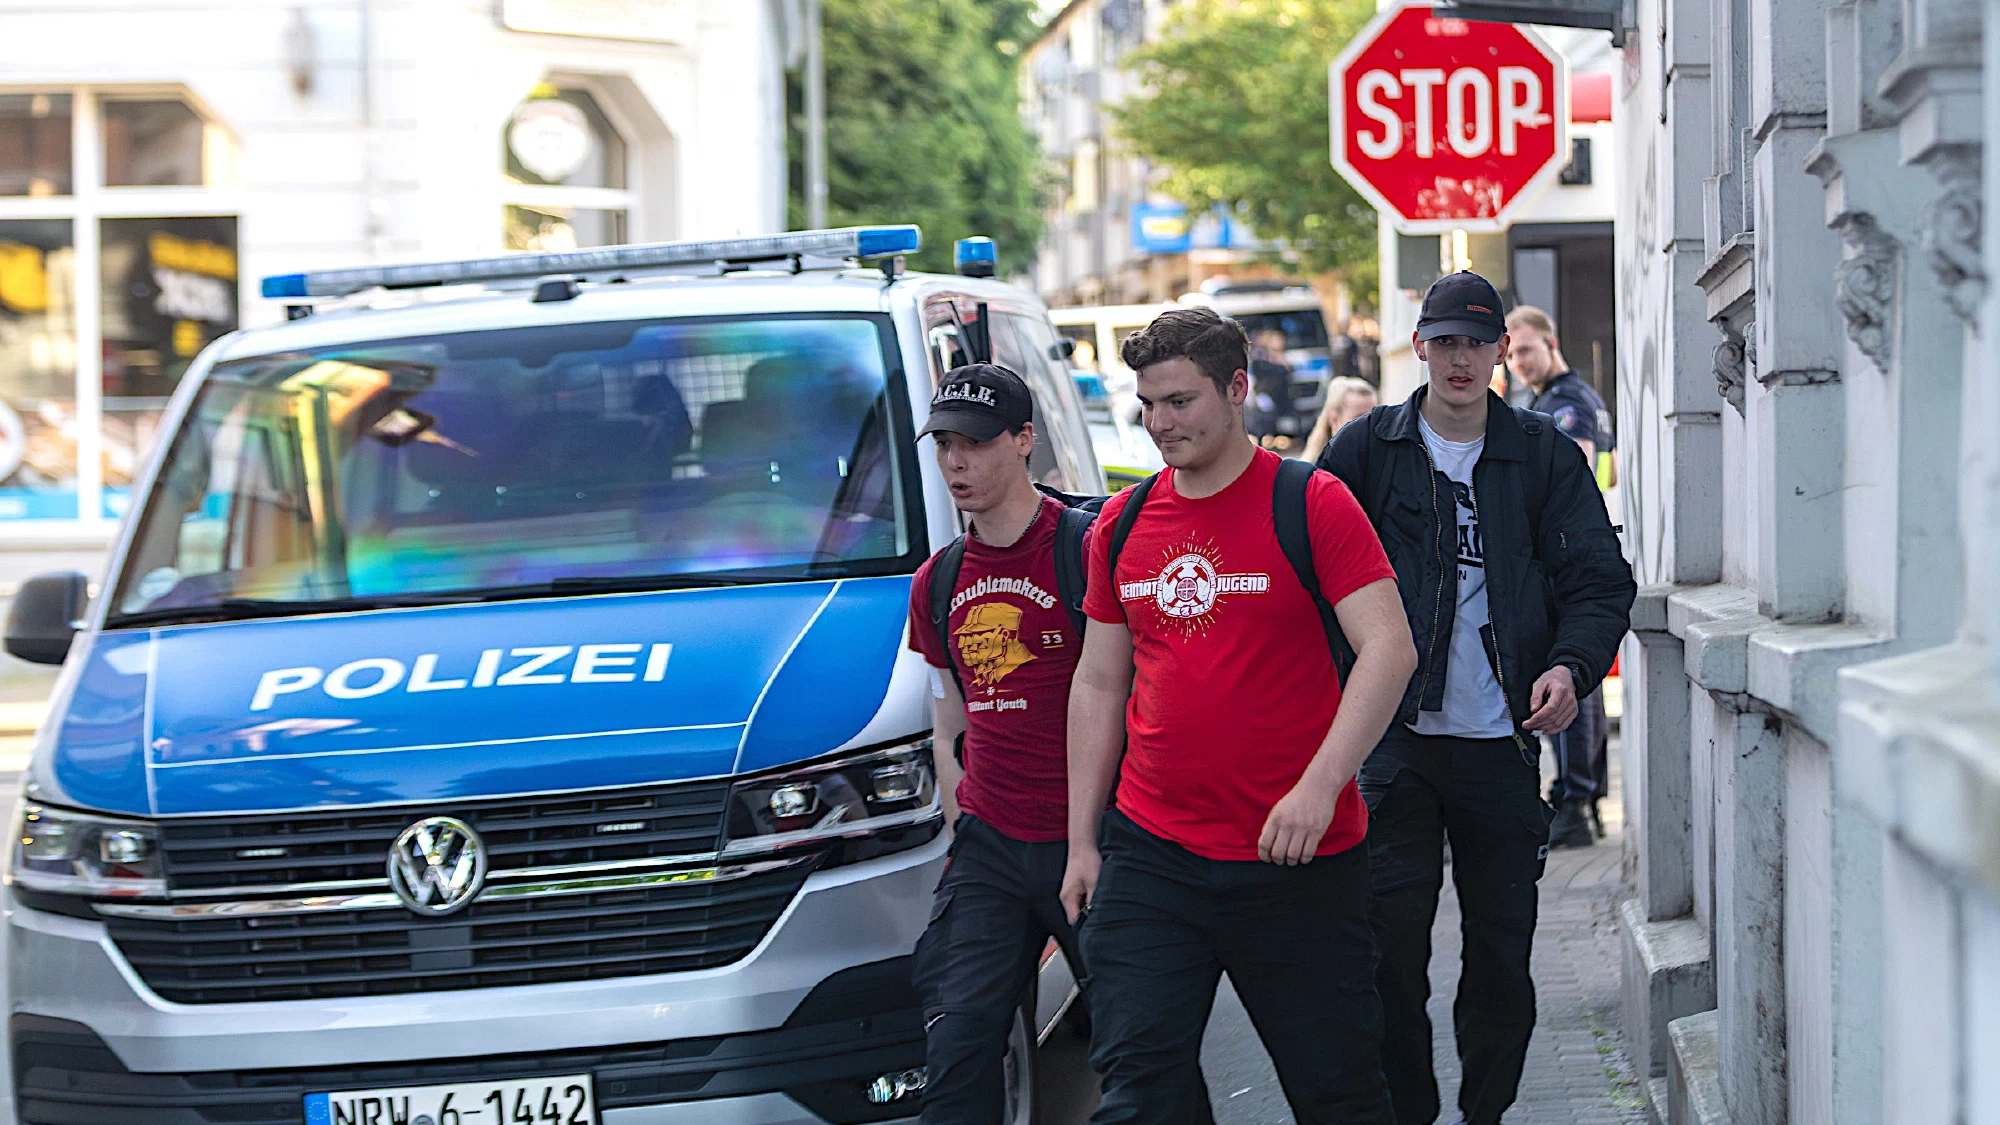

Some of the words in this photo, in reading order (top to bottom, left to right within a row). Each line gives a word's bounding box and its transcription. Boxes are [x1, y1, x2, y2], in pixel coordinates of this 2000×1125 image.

[1355, 65, 1544, 160] STOP
[949, 575, 1058, 616] roublemakers
[1215, 576, 1267, 593] JUGEND
[249, 643, 673, 711] POLIZEI
[996, 698, 1028, 712] Youth
[332, 1096, 410, 1125] NRW
[438, 1084, 589, 1125] 6-1442
